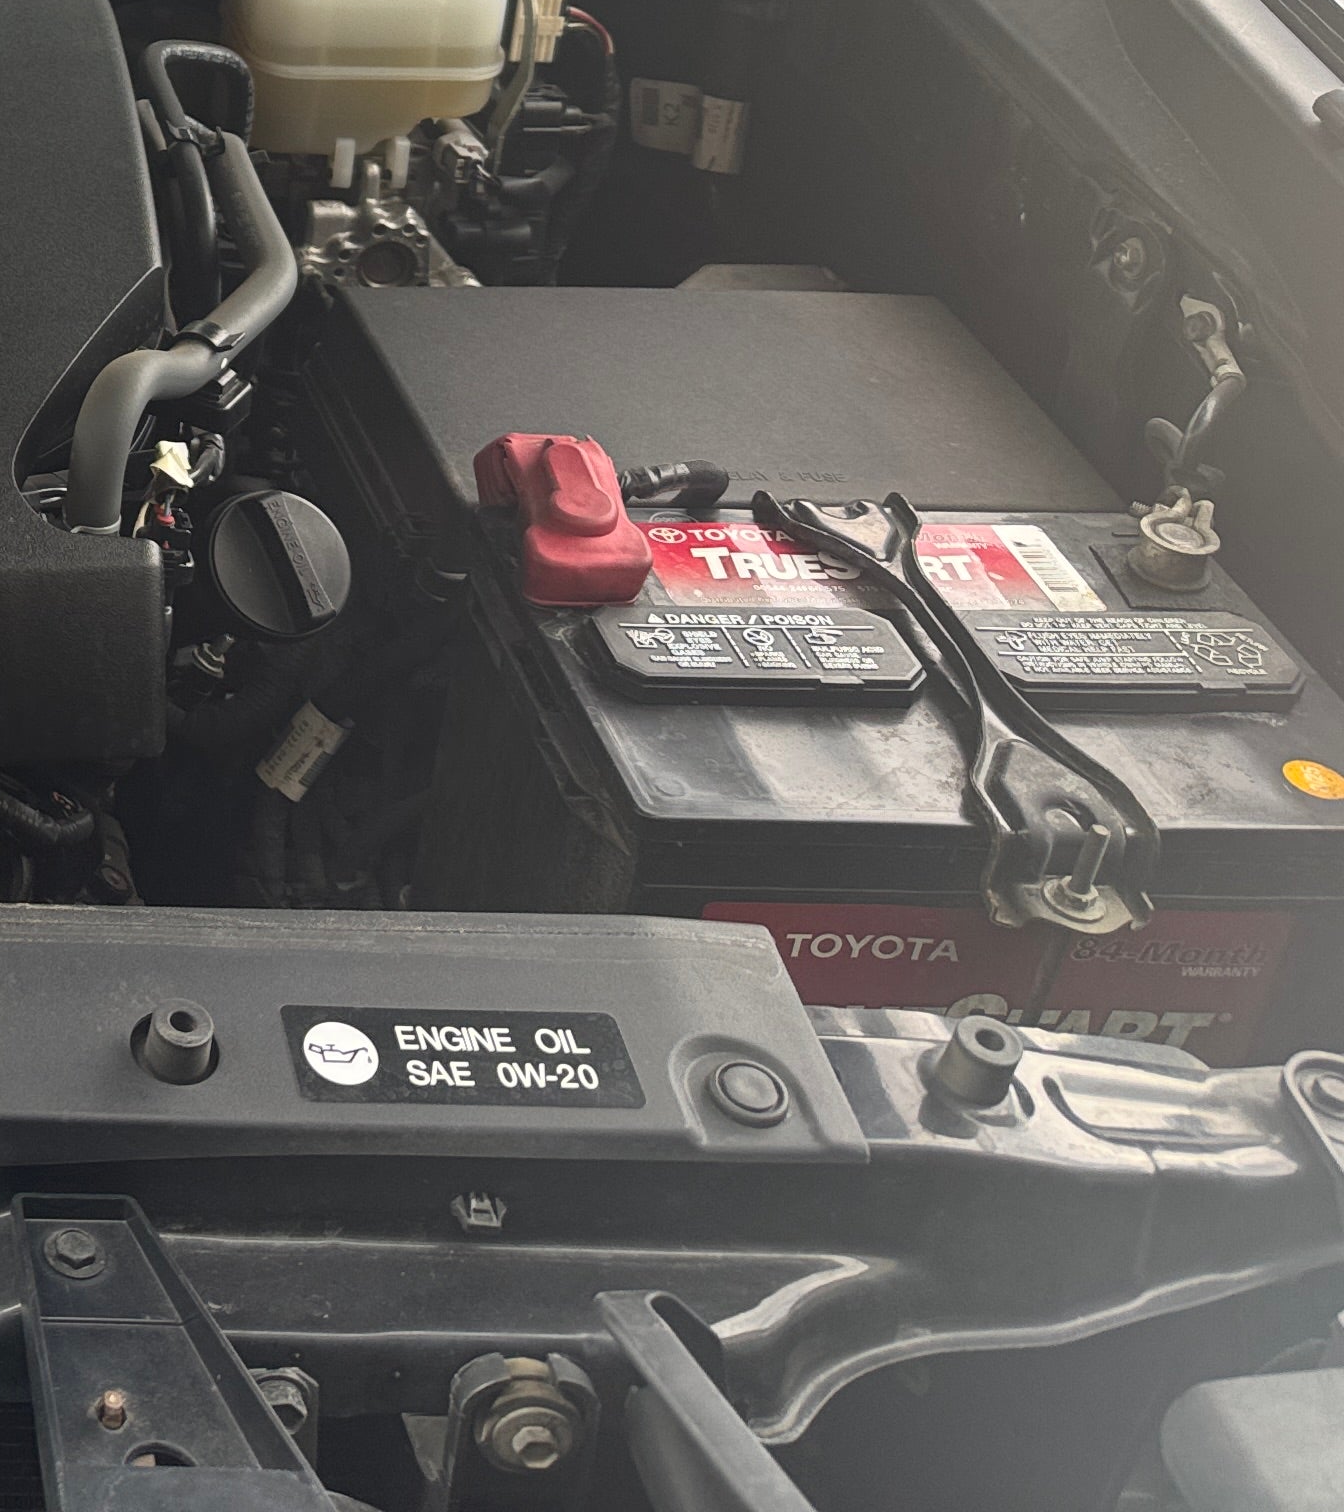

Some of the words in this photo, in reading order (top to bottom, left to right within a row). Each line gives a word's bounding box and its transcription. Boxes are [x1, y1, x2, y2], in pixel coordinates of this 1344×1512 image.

[723, 471, 769, 482] ELAY
[797, 471, 849, 483] FUSE
[690, 529, 795, 543] TOYOTA
[664, 614, 745, 624] DANGER
[763, 615, 836, 625] POISON
[785, 933, 960, 963] TOYOTA
[1070, 938, 1268, 968] 84-Month
[1181, 966, 1261, 977] WARRANTY
[394, 1025, 516, 1053] ENGINE
[534, 1028, 592, 1055] OIL
[406, 1060, 476, 1087] SAE
[496, 1062, 600, 1090] 0W-20
